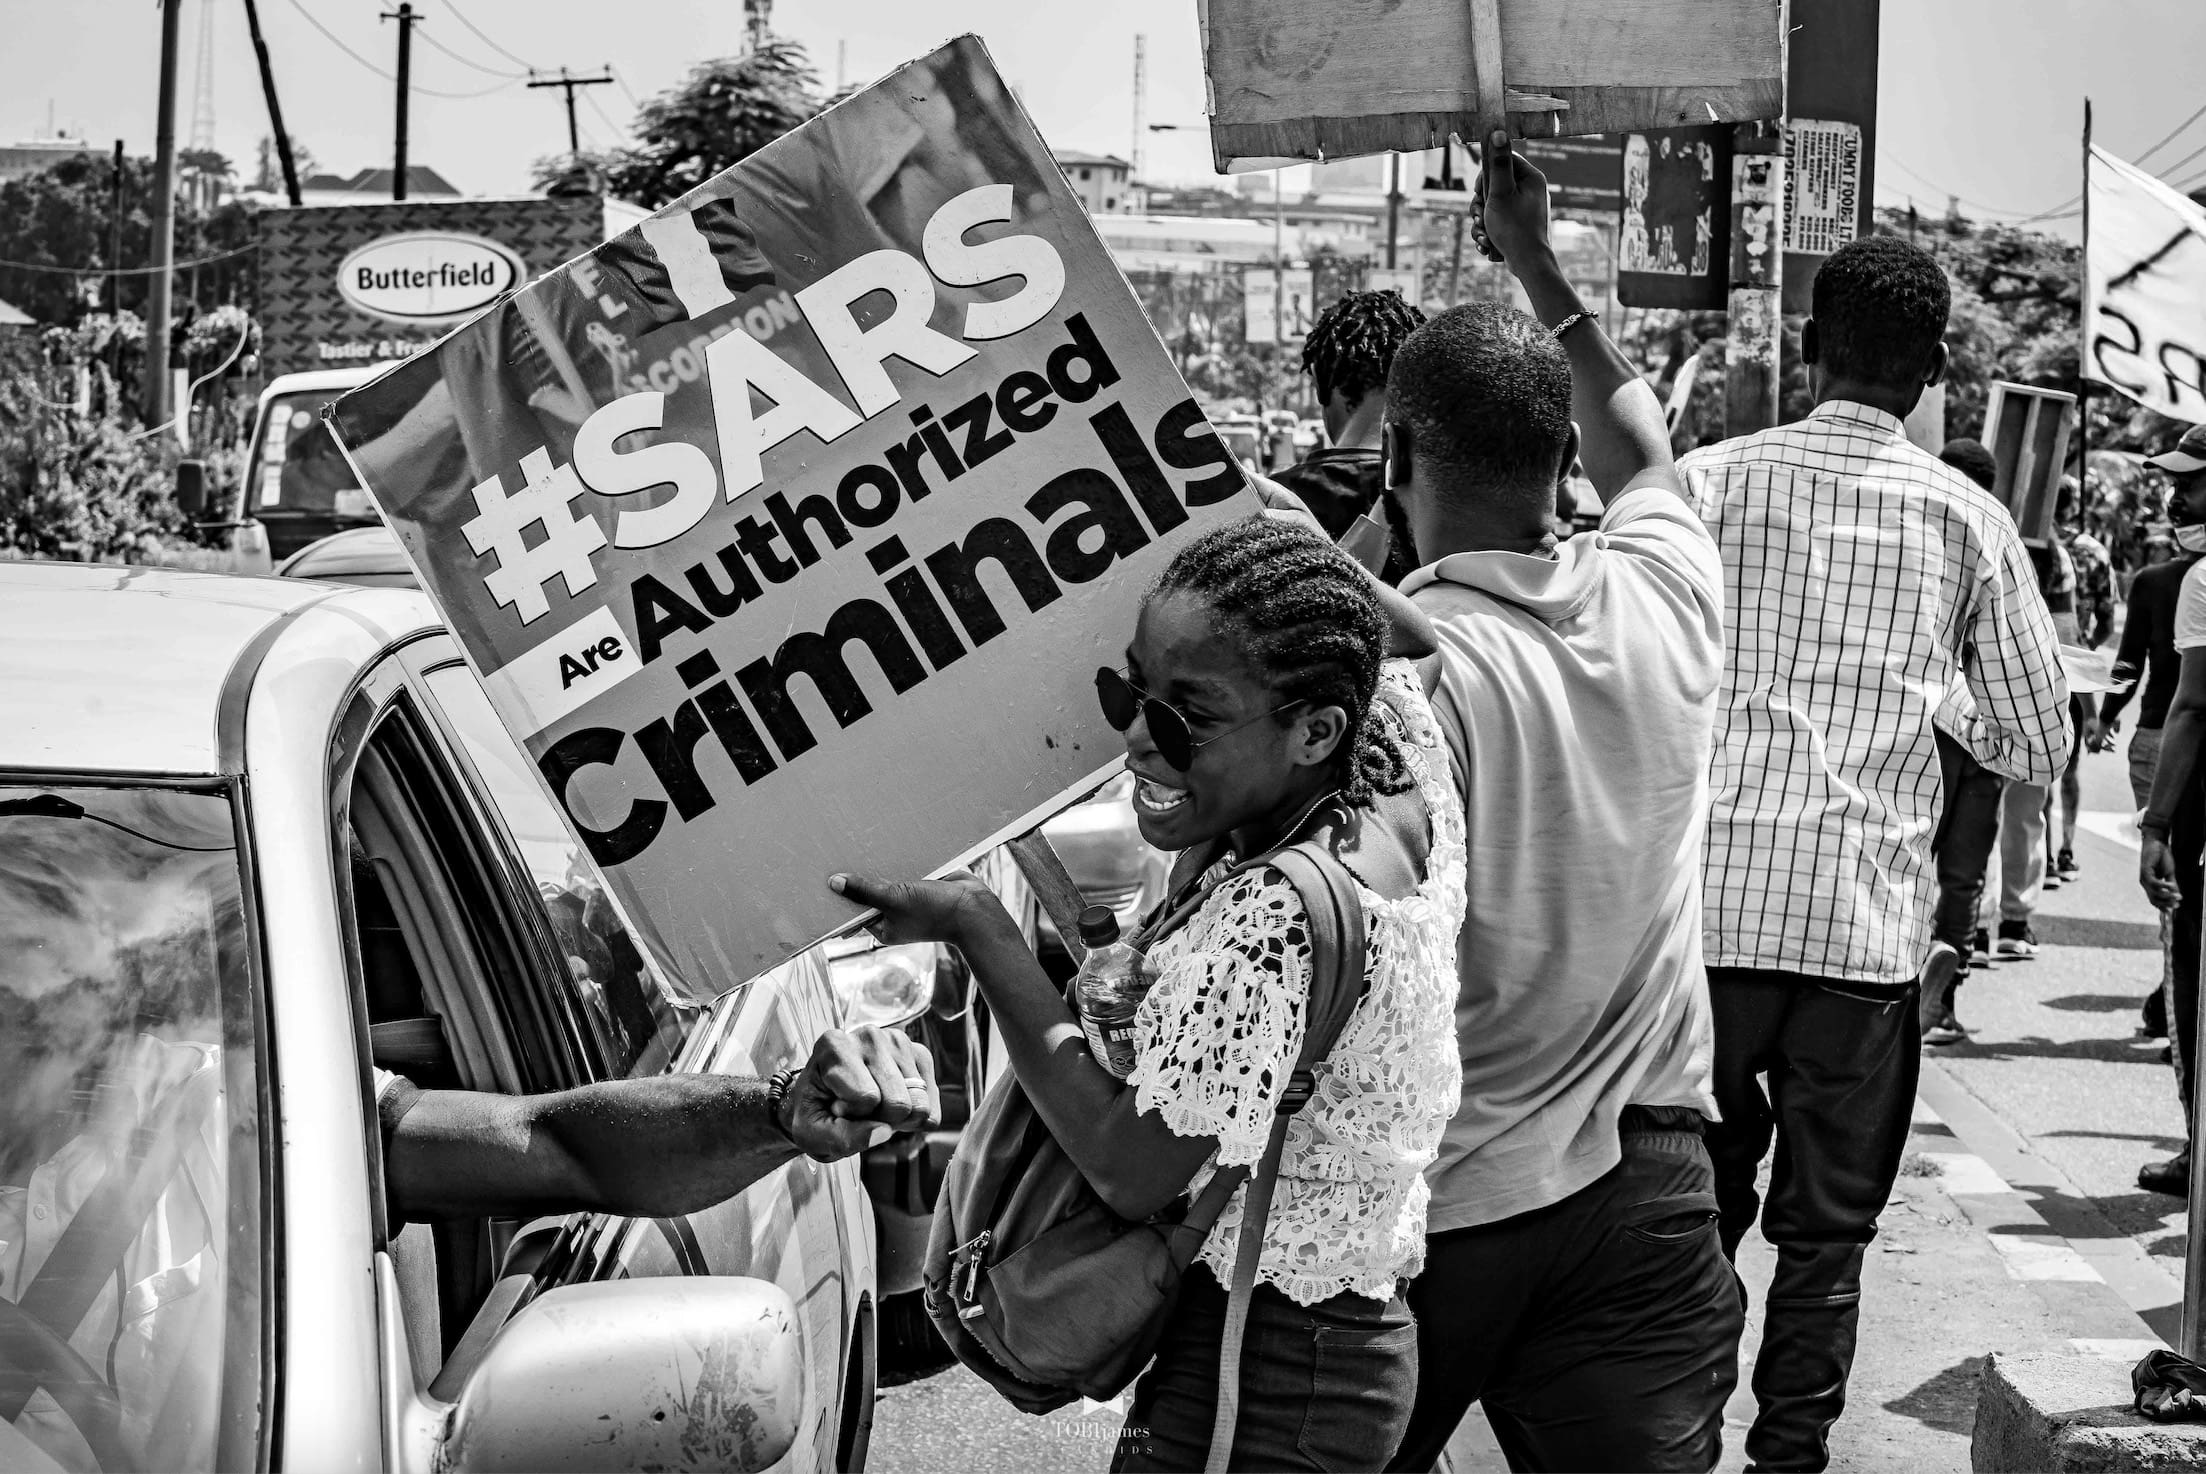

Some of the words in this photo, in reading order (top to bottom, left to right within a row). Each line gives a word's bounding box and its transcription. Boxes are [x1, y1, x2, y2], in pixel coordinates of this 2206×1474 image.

[318, 341, 374, 360] Tastier
[377, 340, 393, 358] &
[357, 261, 495, 290] Butterfield
[460, 183, 1066, 626] #SARS
[536, 397, 1247, 868] Criminals
[558, 633, 624, 690] Are
[630, 311, 1122, 666] Authorized
